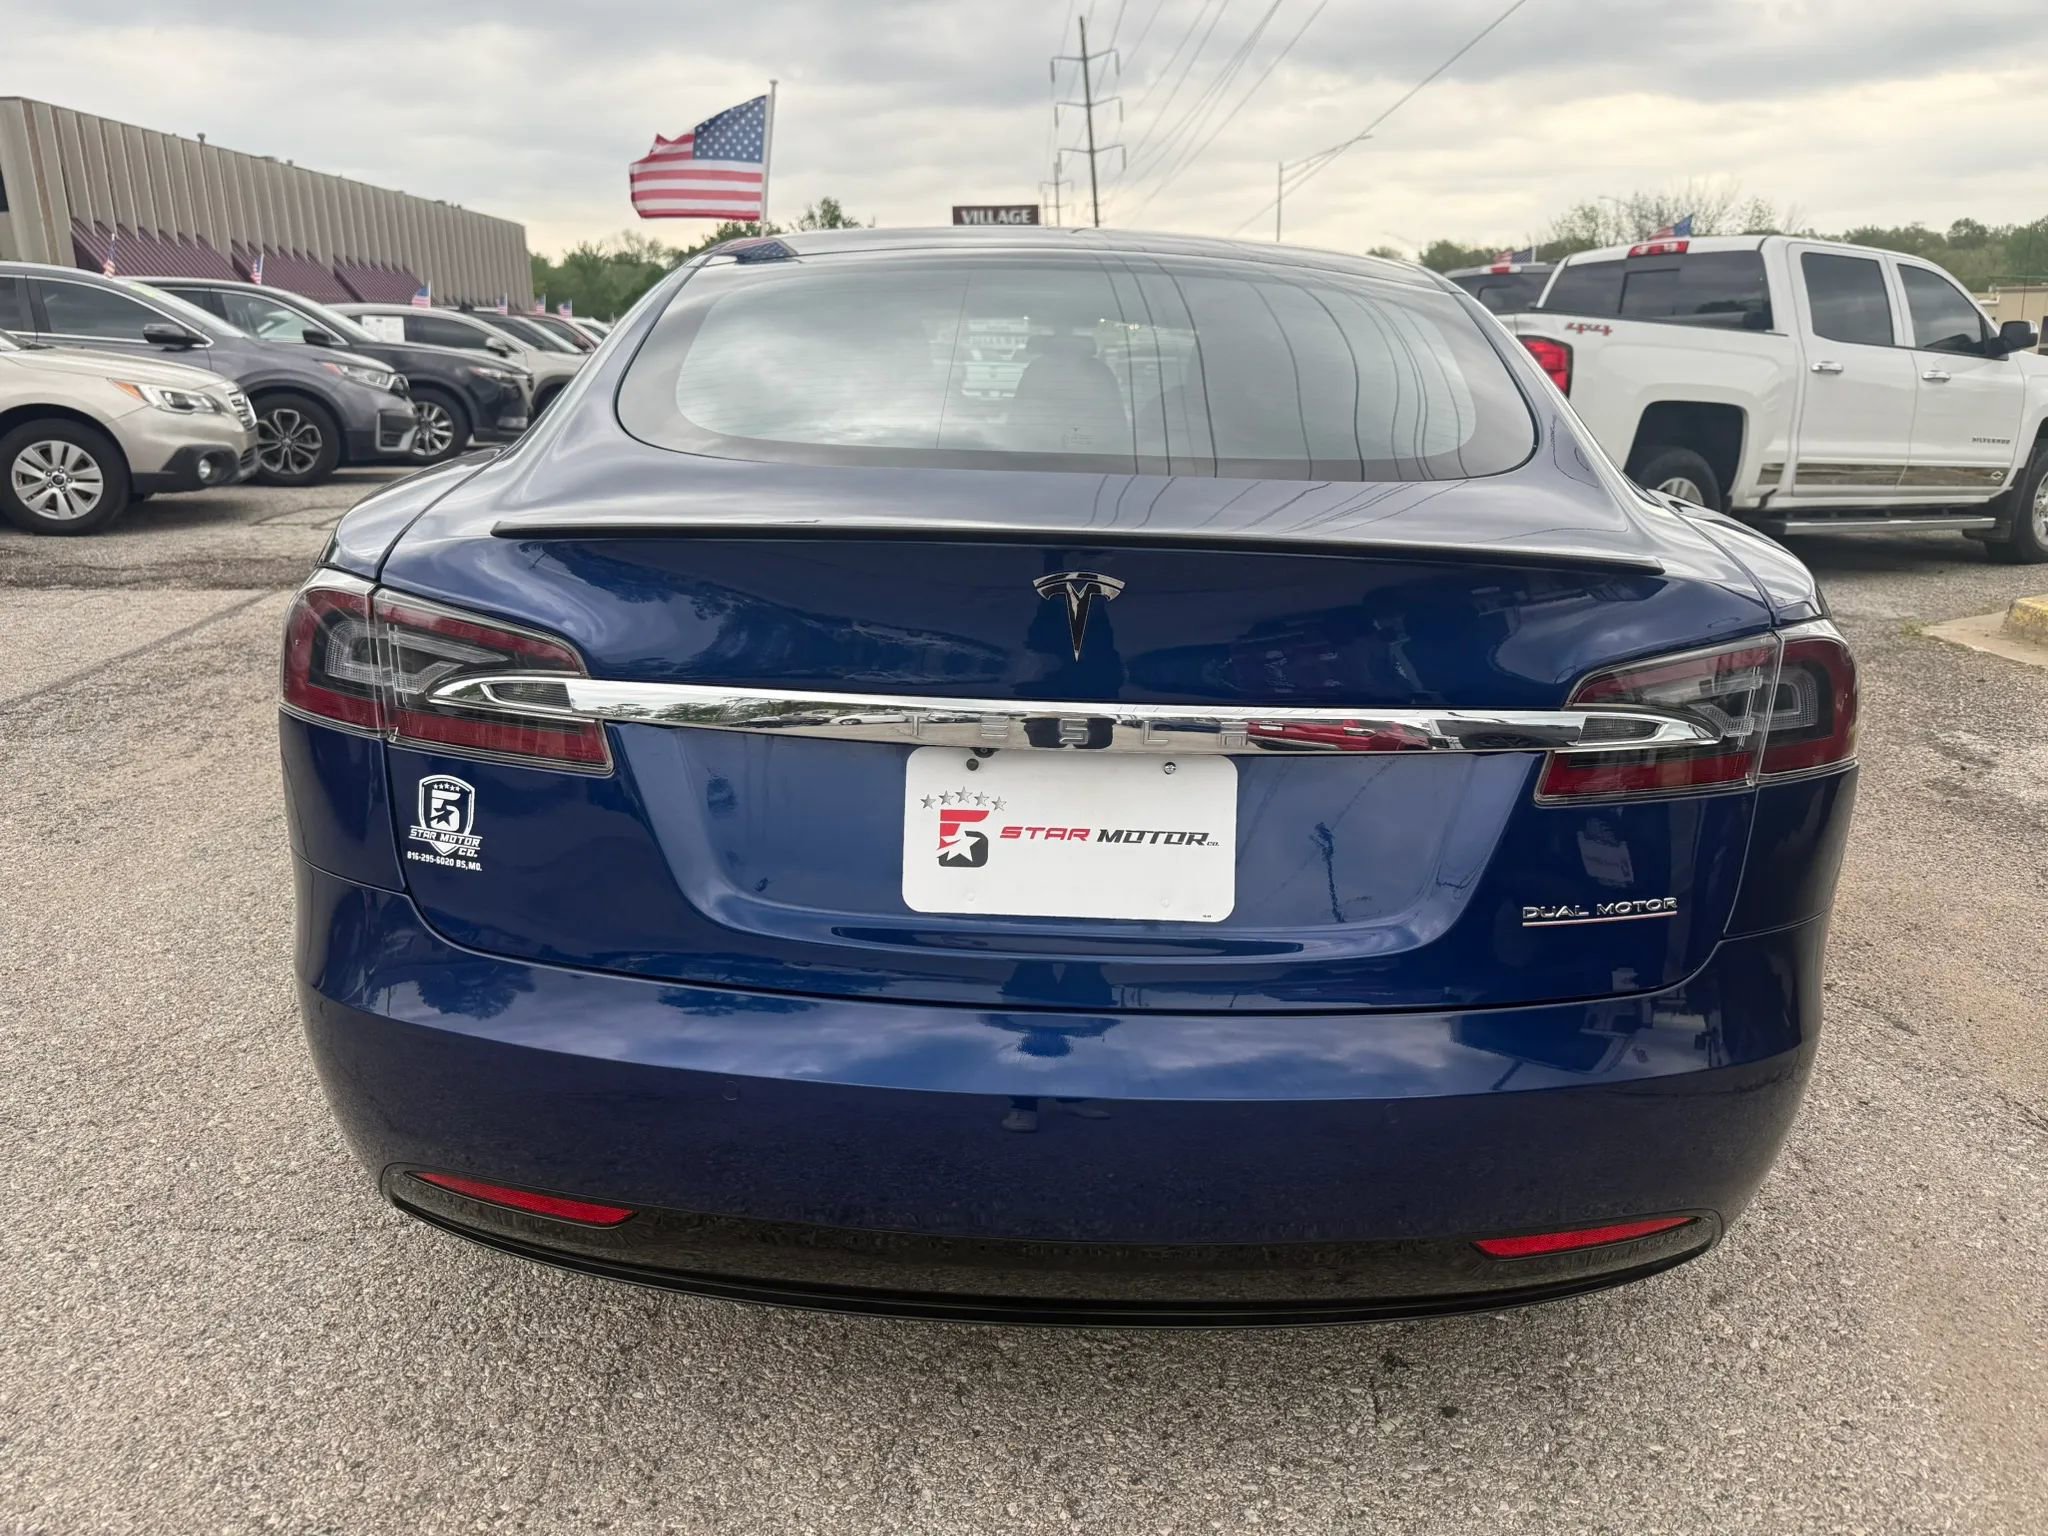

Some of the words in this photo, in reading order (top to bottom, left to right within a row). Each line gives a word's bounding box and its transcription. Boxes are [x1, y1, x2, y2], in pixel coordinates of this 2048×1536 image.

[961, 209, 1032, 224] VILLAGE
[901, 710, 1249, 747] TESLA
[410, 828, 437, 840] STAR
[440, 833, 480, 847] MOTOR
[999, 826, 1092, 842] STAR
[1097, 829, 1209, 847] MOTOR
[407, 850, 454, 866] 816-295-6020
[458, 847, 478, 858] CO.
[1522, 905, 1590, 919] DUAL
[1596, 897, 1678, 915] MOTOR
